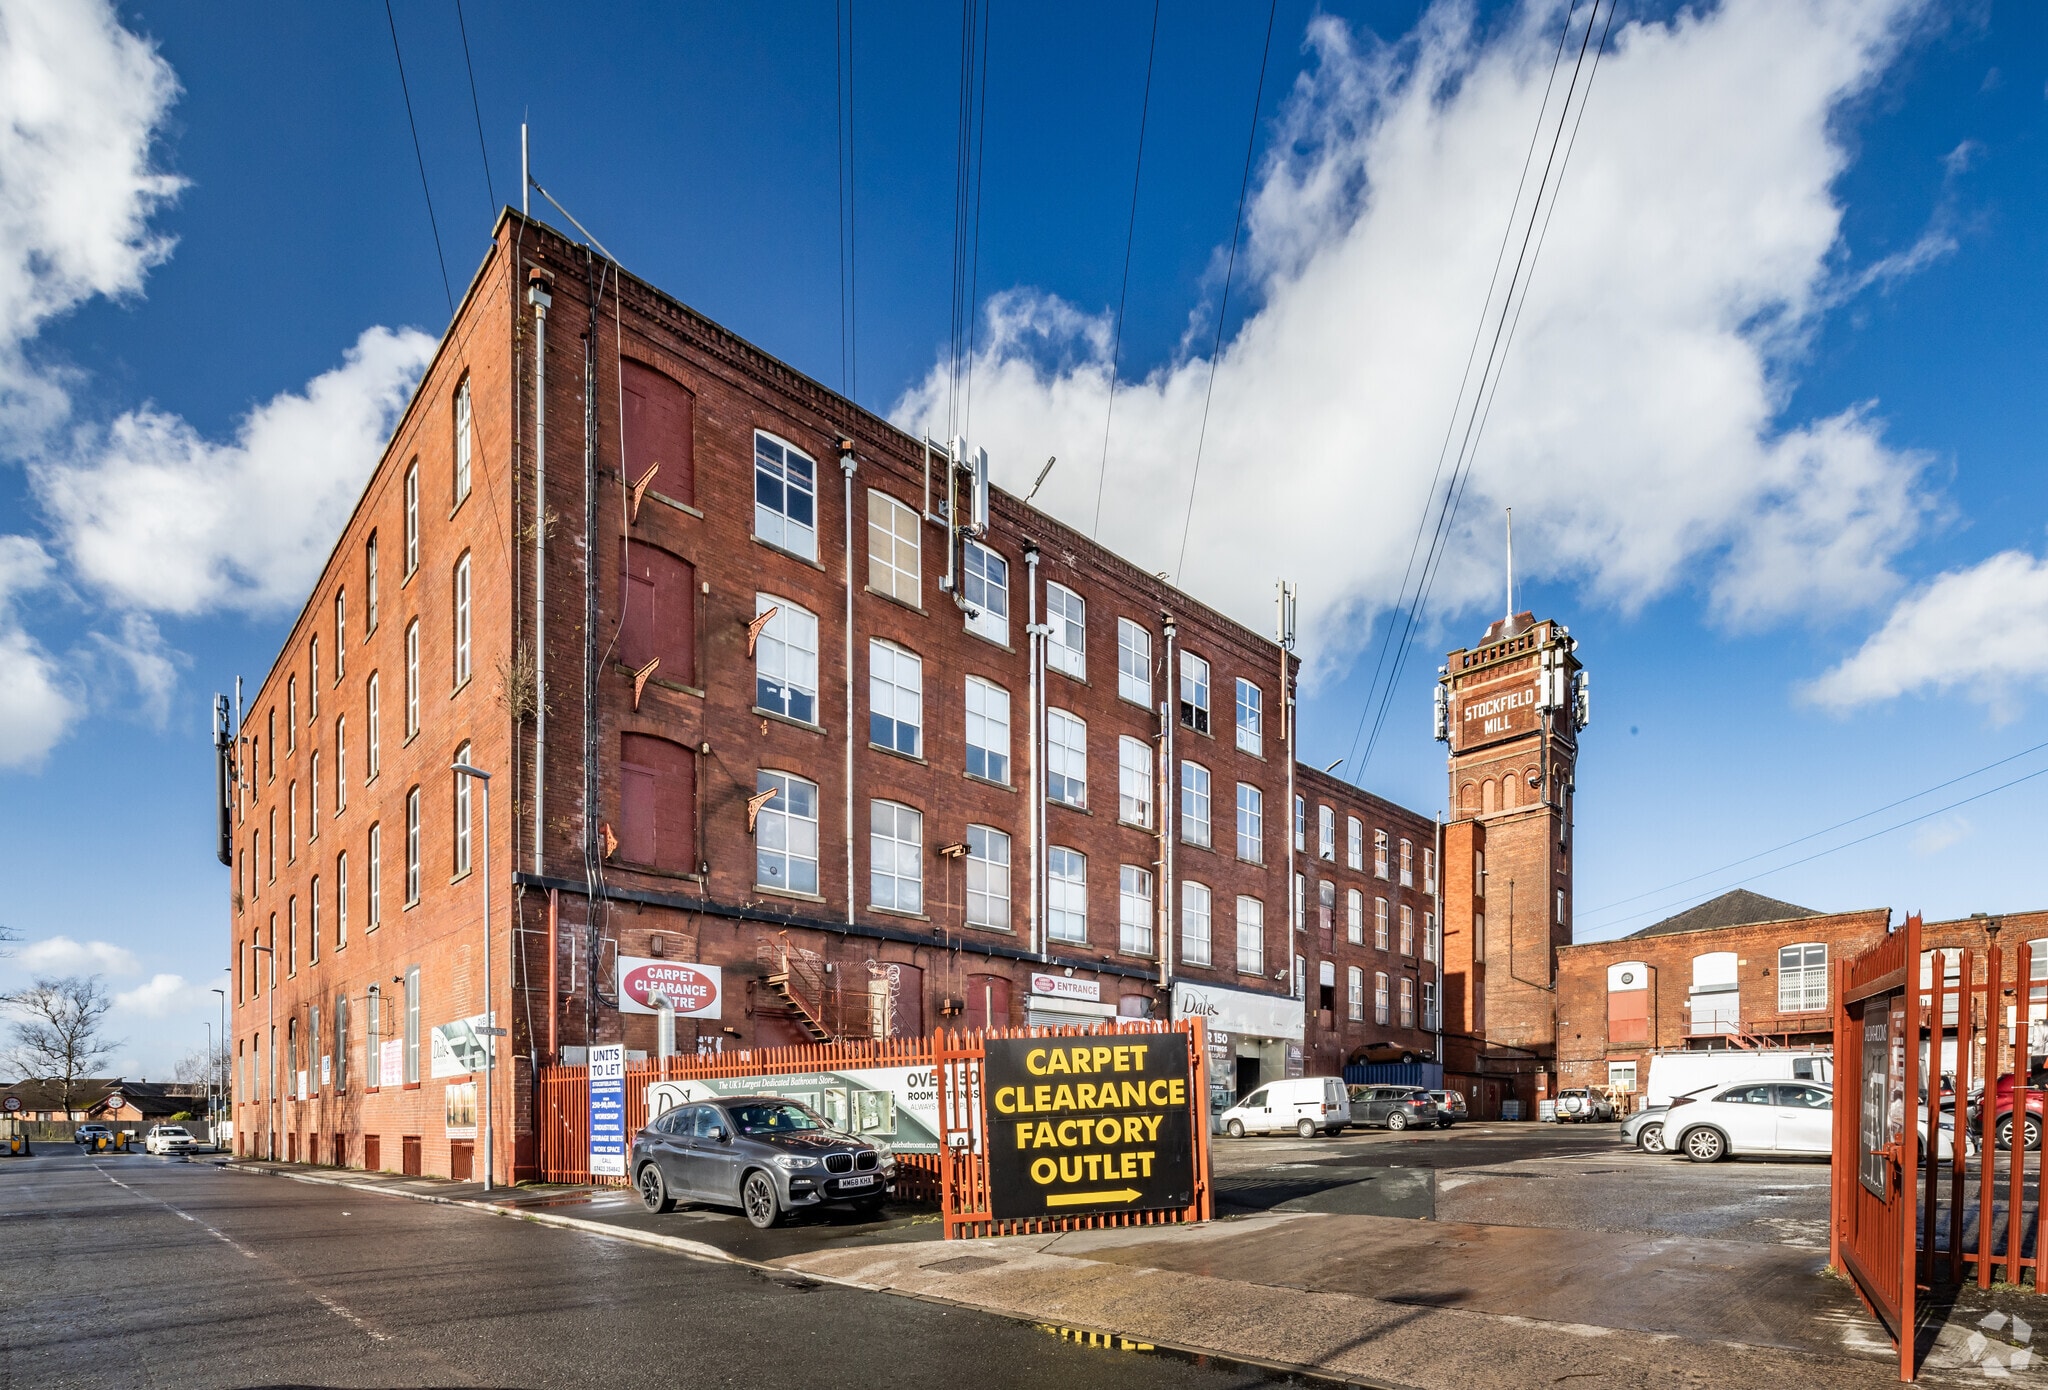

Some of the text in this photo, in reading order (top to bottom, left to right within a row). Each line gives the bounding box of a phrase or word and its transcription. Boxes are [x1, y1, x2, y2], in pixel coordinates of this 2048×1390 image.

[1465, 689, 1533, 722] STOCKFIELD
[1484, 715, 1511, 735] MILL
[647, 967, 695, 982] CARPET
[634, 979, 707, 997] CLEARANCE
[1057, 982, 1097, 995] ENTRANCE
[669, 996, 695, 1008] TRE
[1182, 992, 1219, 1016] Dale
[1213, 1032, 1228, 1044] 150
[593, 1048, 619, 1061] UNITS
[1207, 1044, 1228, 1053] ETTINGS
[1026, 1045, 1148, 1076] CARPET
[592, 1064, 620, 1076] TO LET
[719, 1080, 728, 1089] The
[729, 1080, 741, 1089] UK's
[742, 1079, 761, 1090] Largest
[762, 1078, 790, 1088] Dedicated
[790, 1077, 818, 1086] Bathroom
[957, 1070, 978, 1086] 50
[908, 1091, 933, 1100] ROOM
[994, 1079, 1185, 1114] CLEARANCE
[1016, 1115, 1164, 1149] FACTORY
[1030, 1151, 1155, 1185] OUTLET
[842, 1177, 872, 1187] MM68 KHX
